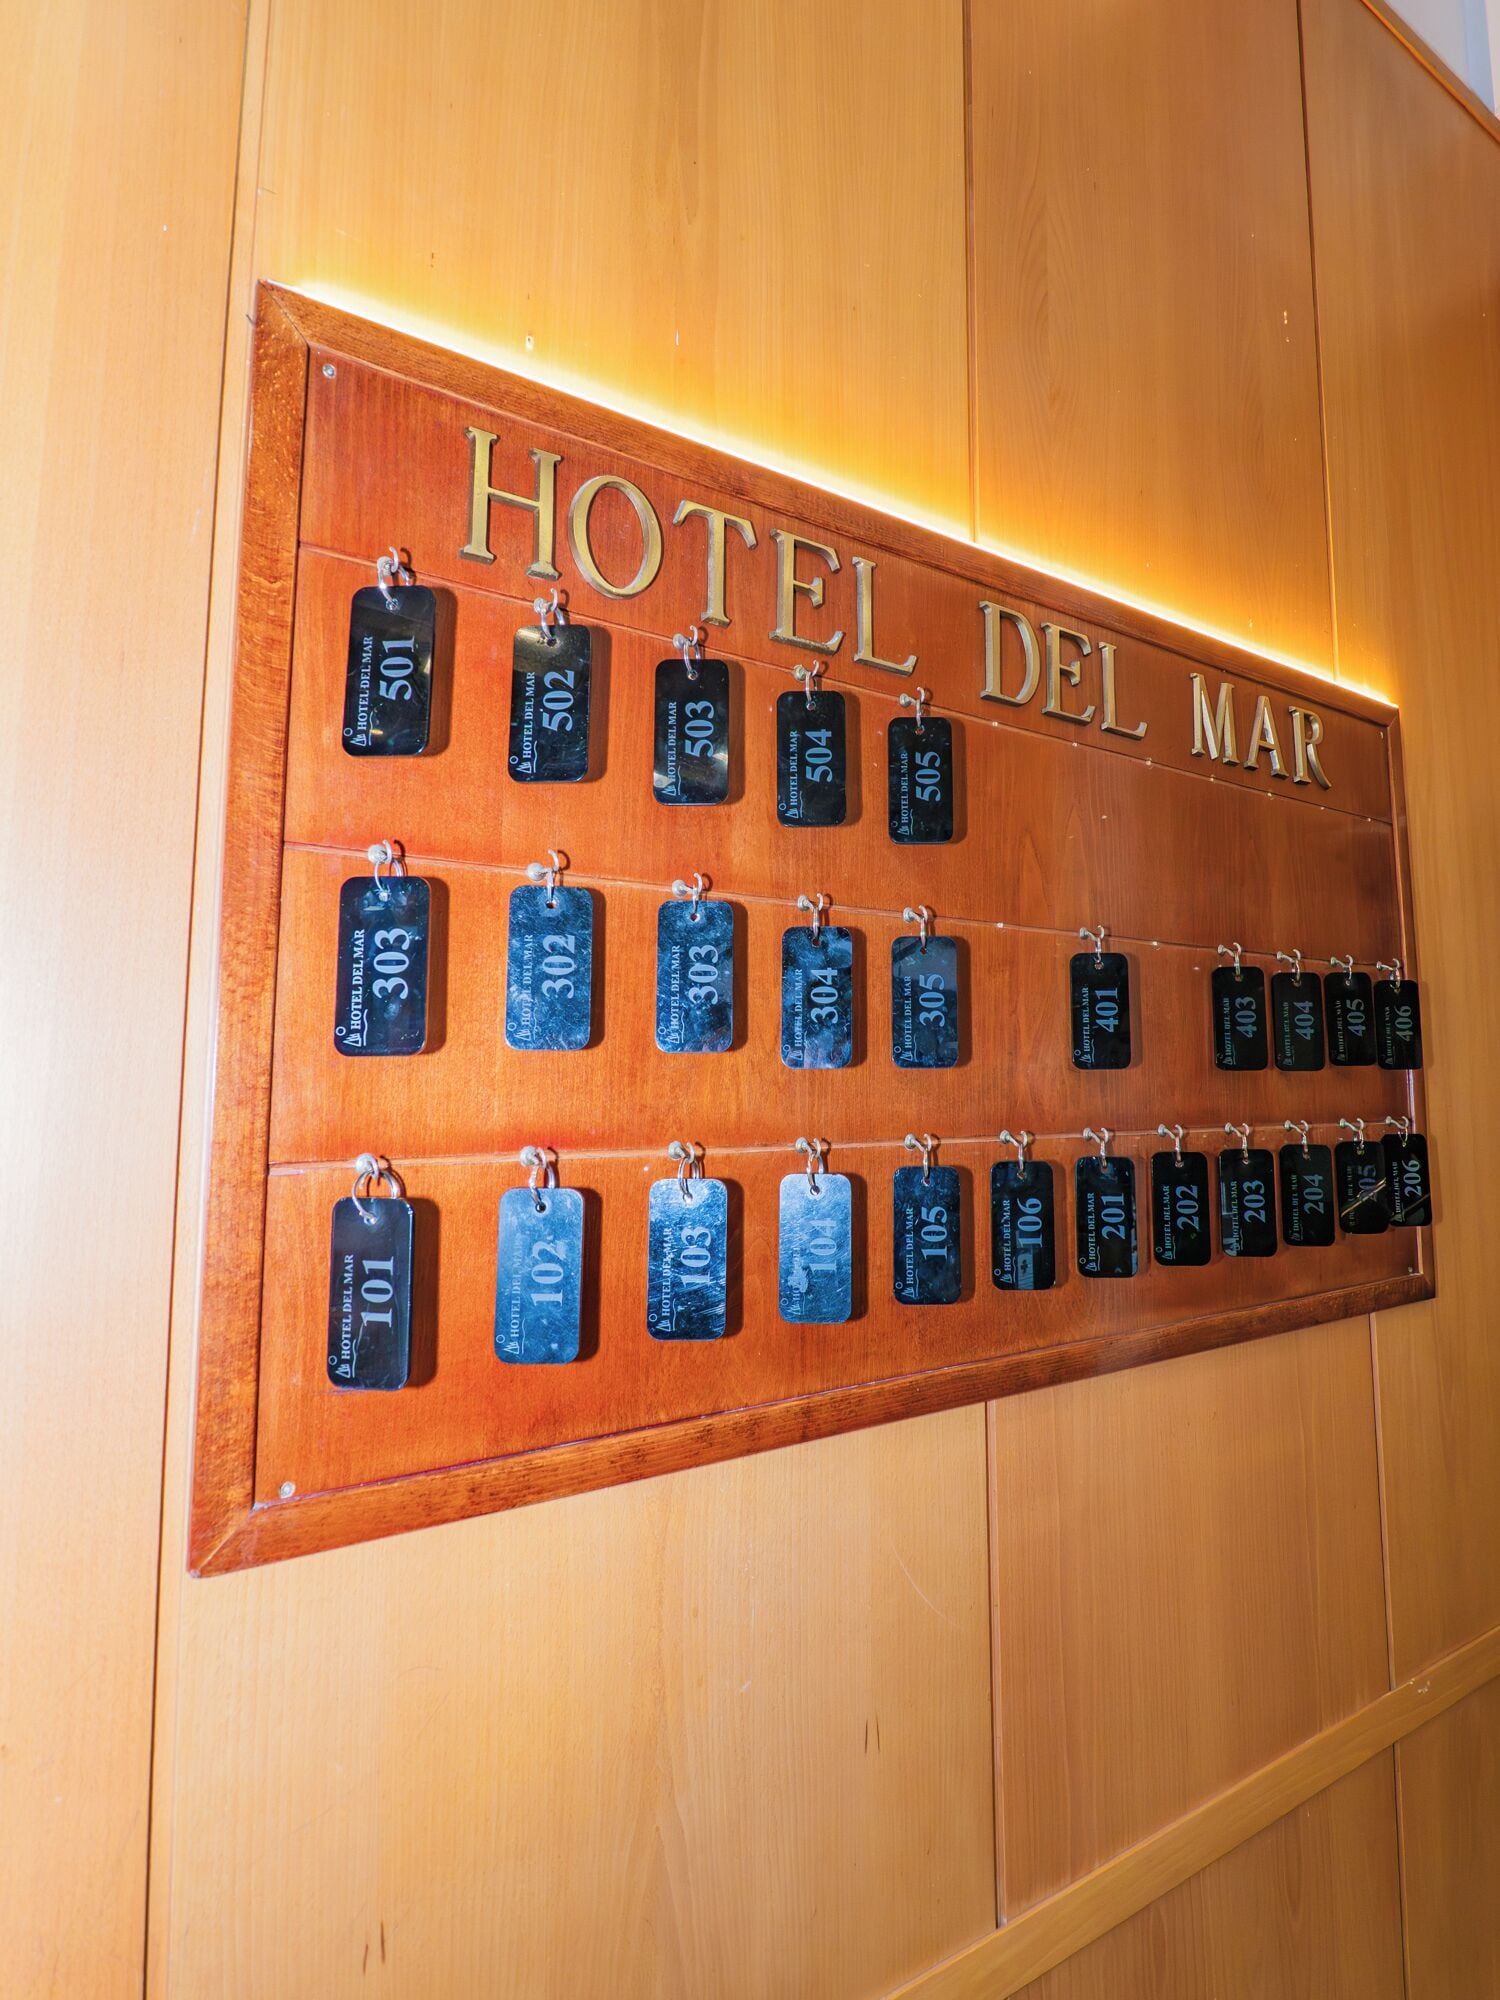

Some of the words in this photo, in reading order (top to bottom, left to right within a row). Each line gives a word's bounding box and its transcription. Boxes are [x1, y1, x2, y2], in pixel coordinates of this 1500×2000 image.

[459, 426, 917, 677] HOTEL
[978, 600, 1147, 740] DEL
[1189, 672, 1332, 789] MAR
[362, 636, 373, 663] MAR
[379, 635, 415, 700] 501
[360, 665, 371, 688] DEL
[526, 672, 535, 697] MAR
[357, 691, 369, 730] HOTEL
[524, 698, 534, 719] DEL
[542, 669, 575, 732] 502
[668, 702, 676, 724] MAR
[523, 721, 533, 758] HOTEL
[668, 724, 676, 746] DEL
[685, 700, 714, 757] 503
[790, 730, 798, 752] MAR
[668, 747, 676, 782] HOTEL
[805, 729, 833, 783] 504
[790, 773, 798, 805] HOTEL
[915, 751, 941, 801] 505
[353, 929, 365, 958] MAR
[524, 934, 534, 960] MAR
[672, 945, 680, 970] MAR
[352, 960, 364, 985] DEL
[372, 928, 410, 999] 303
[523, 962, 533, 984] DEL
[542, 934, 575, 999] 302
[671, 971, 680, 991] DEL
[688, 945, 718, 1005] 303
[795, 969, 803, 991] MAR
[351, 987, 362, 1030] HOTEL
[670, 994, 679, 1029] HOTEL
[810, 967, 838, 1023] 304
[904, 998, 912, 1016] DEL
[919, 974, 945, 1027] 305
[1095, 987, 1119, 1032] 401
[794, 1014, 803, 1047] HOTEL
[904, 1018, 912, 1048] HOTEL
[1235, 996, 1257, 1038] 403
[1293, 1001, 1314, 1040] 404
[1346, 999, 1366, 1037] 405
[1394, 1006, 1414, 1042] 406
[1303, 1174, 1324, 1214] 204
[1402, 1160, 1422, 1197] 206
[1087, 1193, 1095, 1212] MAR
[1101, 1192, 1126, 1240] 201
[1176, 1185, 1199, 1230] 202
[1243, 1180, 1266, 1223] 203
[921, 1206, 947, 1260] 105
[1017, 1198, 1042, 1248] 106
[344, 1254, 354, 1284] MAR
[531, 1240, 567, 1306] 102
[681, 1226, 712, 1288] 103
[906, 1251, 914, 1284] HOTEL
[342, 1287, 353, 1312] DEL
[361, 1256, 394, 1328] 101
[662, 1278, 672, 1316] HOTEL
[341, 1315, 352, 1360] HOTEL
